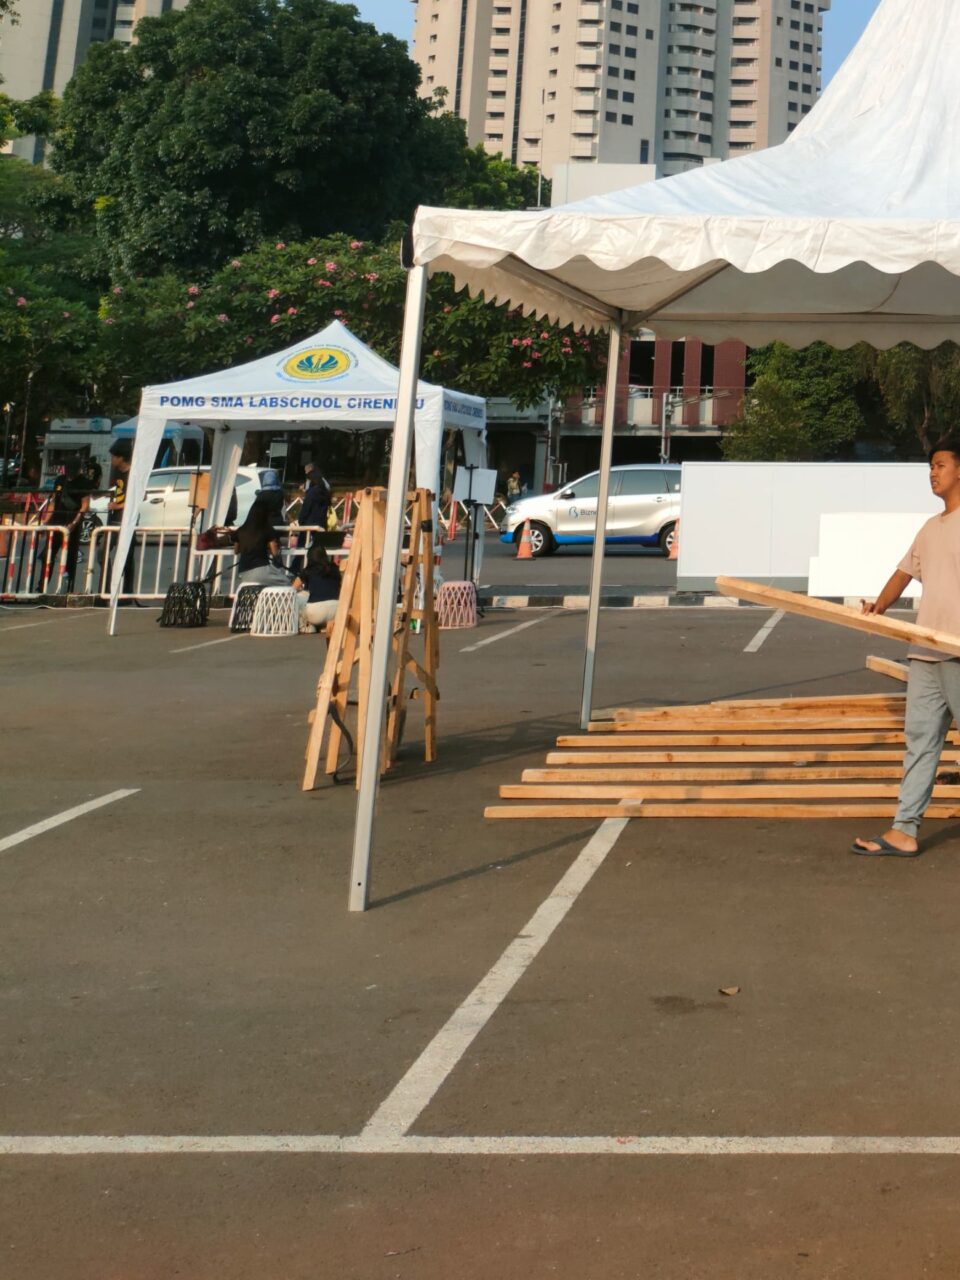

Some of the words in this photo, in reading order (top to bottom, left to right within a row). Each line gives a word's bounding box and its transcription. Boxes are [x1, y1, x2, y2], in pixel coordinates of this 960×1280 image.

[160, 396, 206, 407] POMG
[210, 396, 244, 408] SMA
[249, 396, 342, 409] LABSCHOOL
[347, 397, 425, 409] CIRENU
